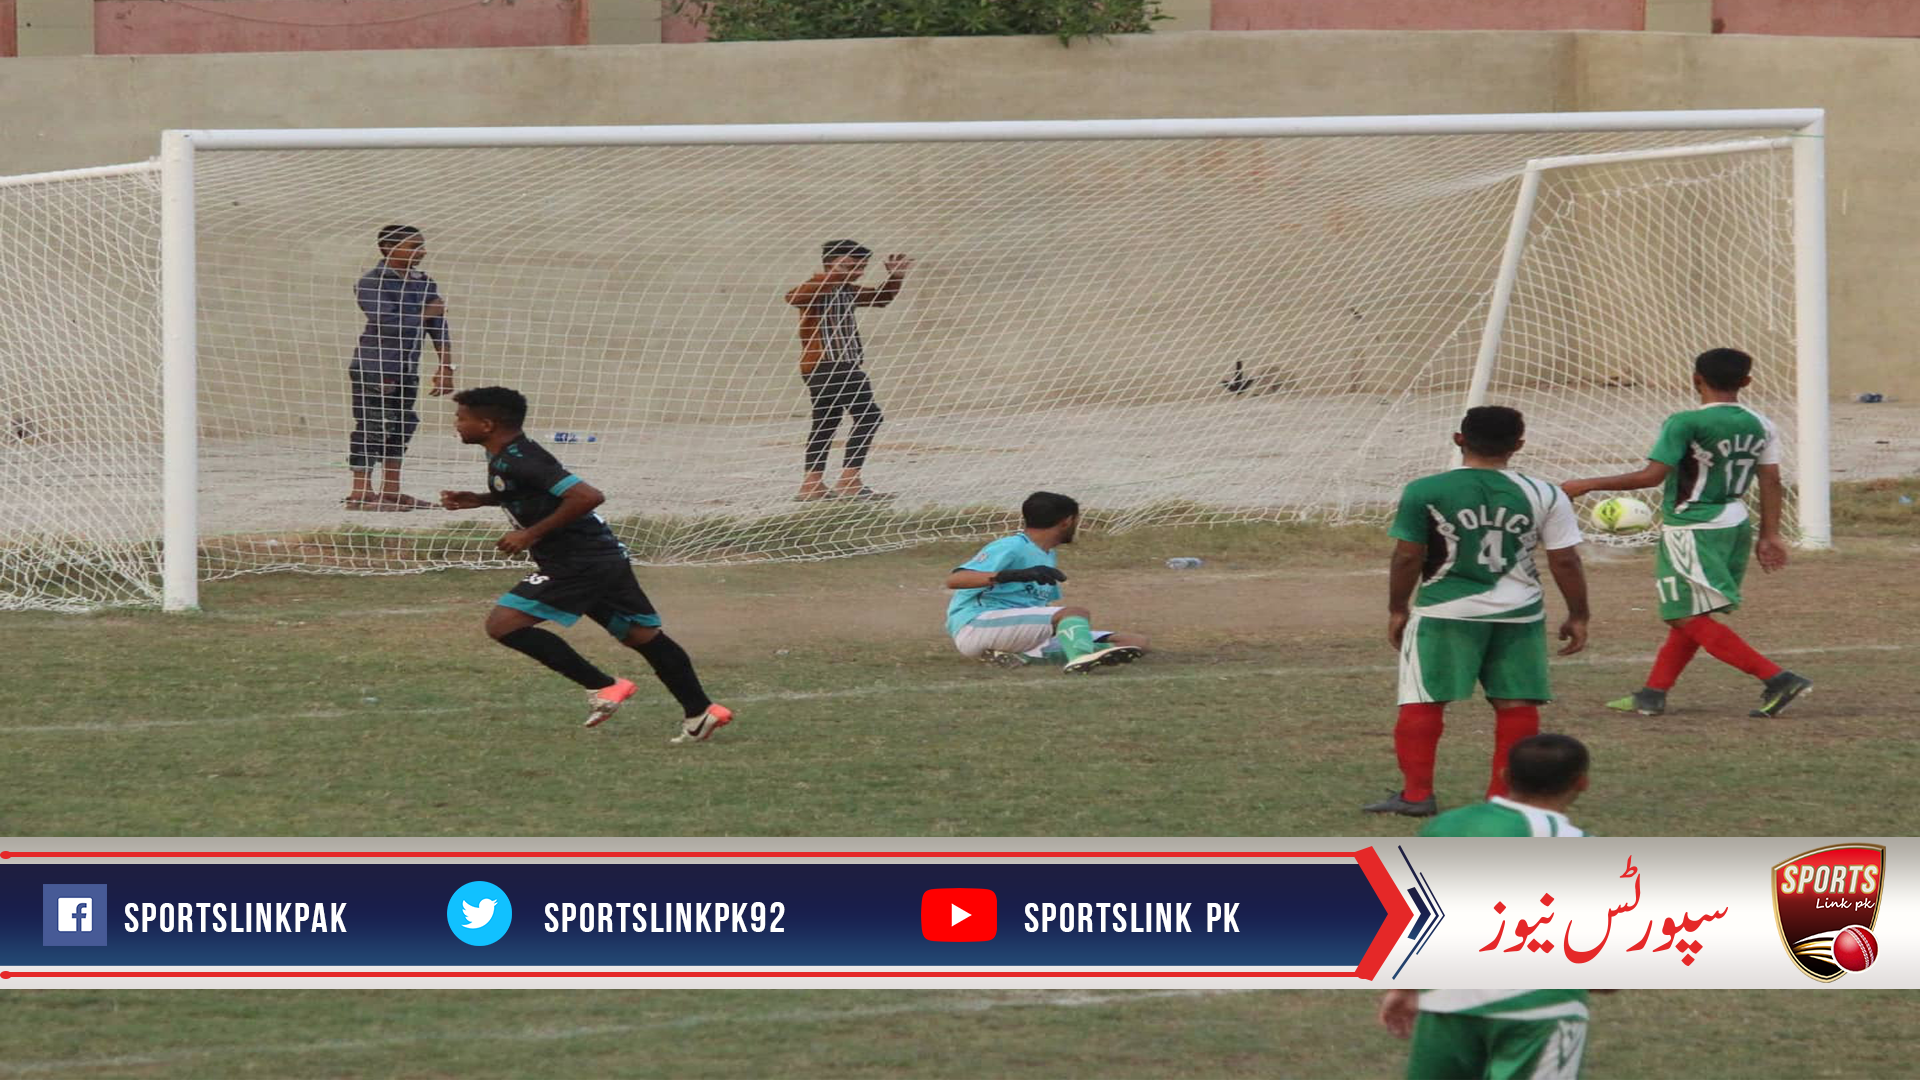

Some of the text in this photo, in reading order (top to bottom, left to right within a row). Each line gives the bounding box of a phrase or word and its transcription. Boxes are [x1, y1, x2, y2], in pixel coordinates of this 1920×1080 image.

[1725, 459, 1755, 494] 17
[1477, 530, 1508, 573] 4
[1655, 576, 1680, 604] 17
